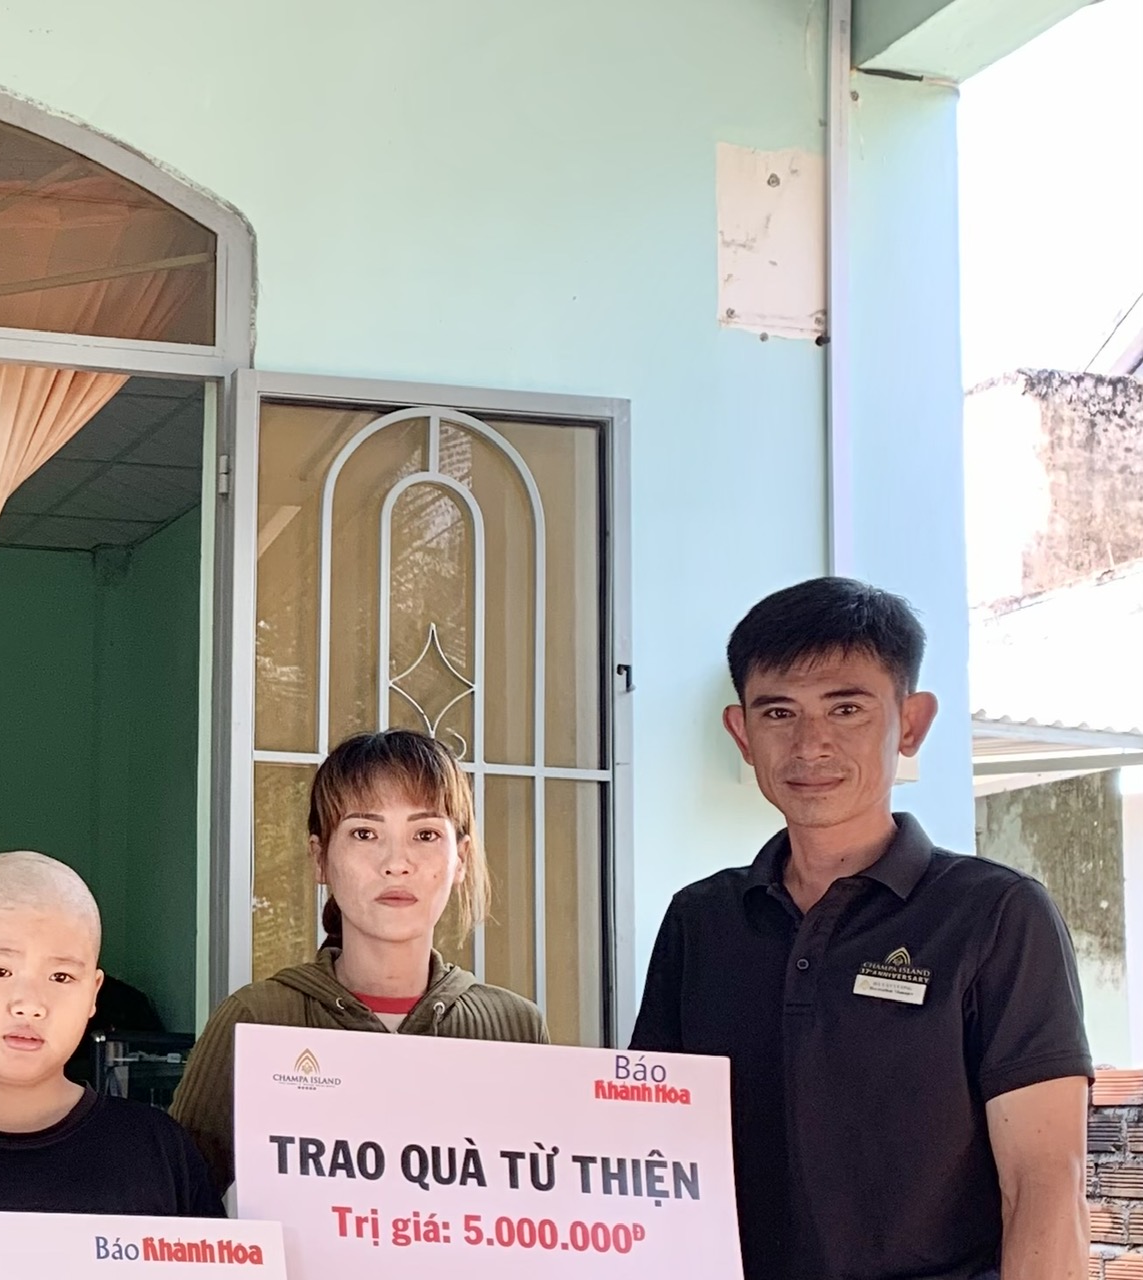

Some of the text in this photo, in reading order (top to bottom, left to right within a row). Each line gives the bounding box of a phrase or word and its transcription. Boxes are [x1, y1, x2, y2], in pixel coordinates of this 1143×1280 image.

[863, 961, 931, 977] CHAMPA ISLAND
[872, 969, 930, 983] ANNIVERSARY
[272, 1073, 308, 1083] CHAMPA
[311, 1076, 341, 1086] ISLAND
[615, 1054, 667, 1083] Báo
[269, 1134, 701, 1207] TRAO QUÀ TỪ THIỆN
[331, 1206, 380, 1247] Trị
[391, 1210, 451, 1247] giá:
[95, 1235, 140, 1261] Báo
